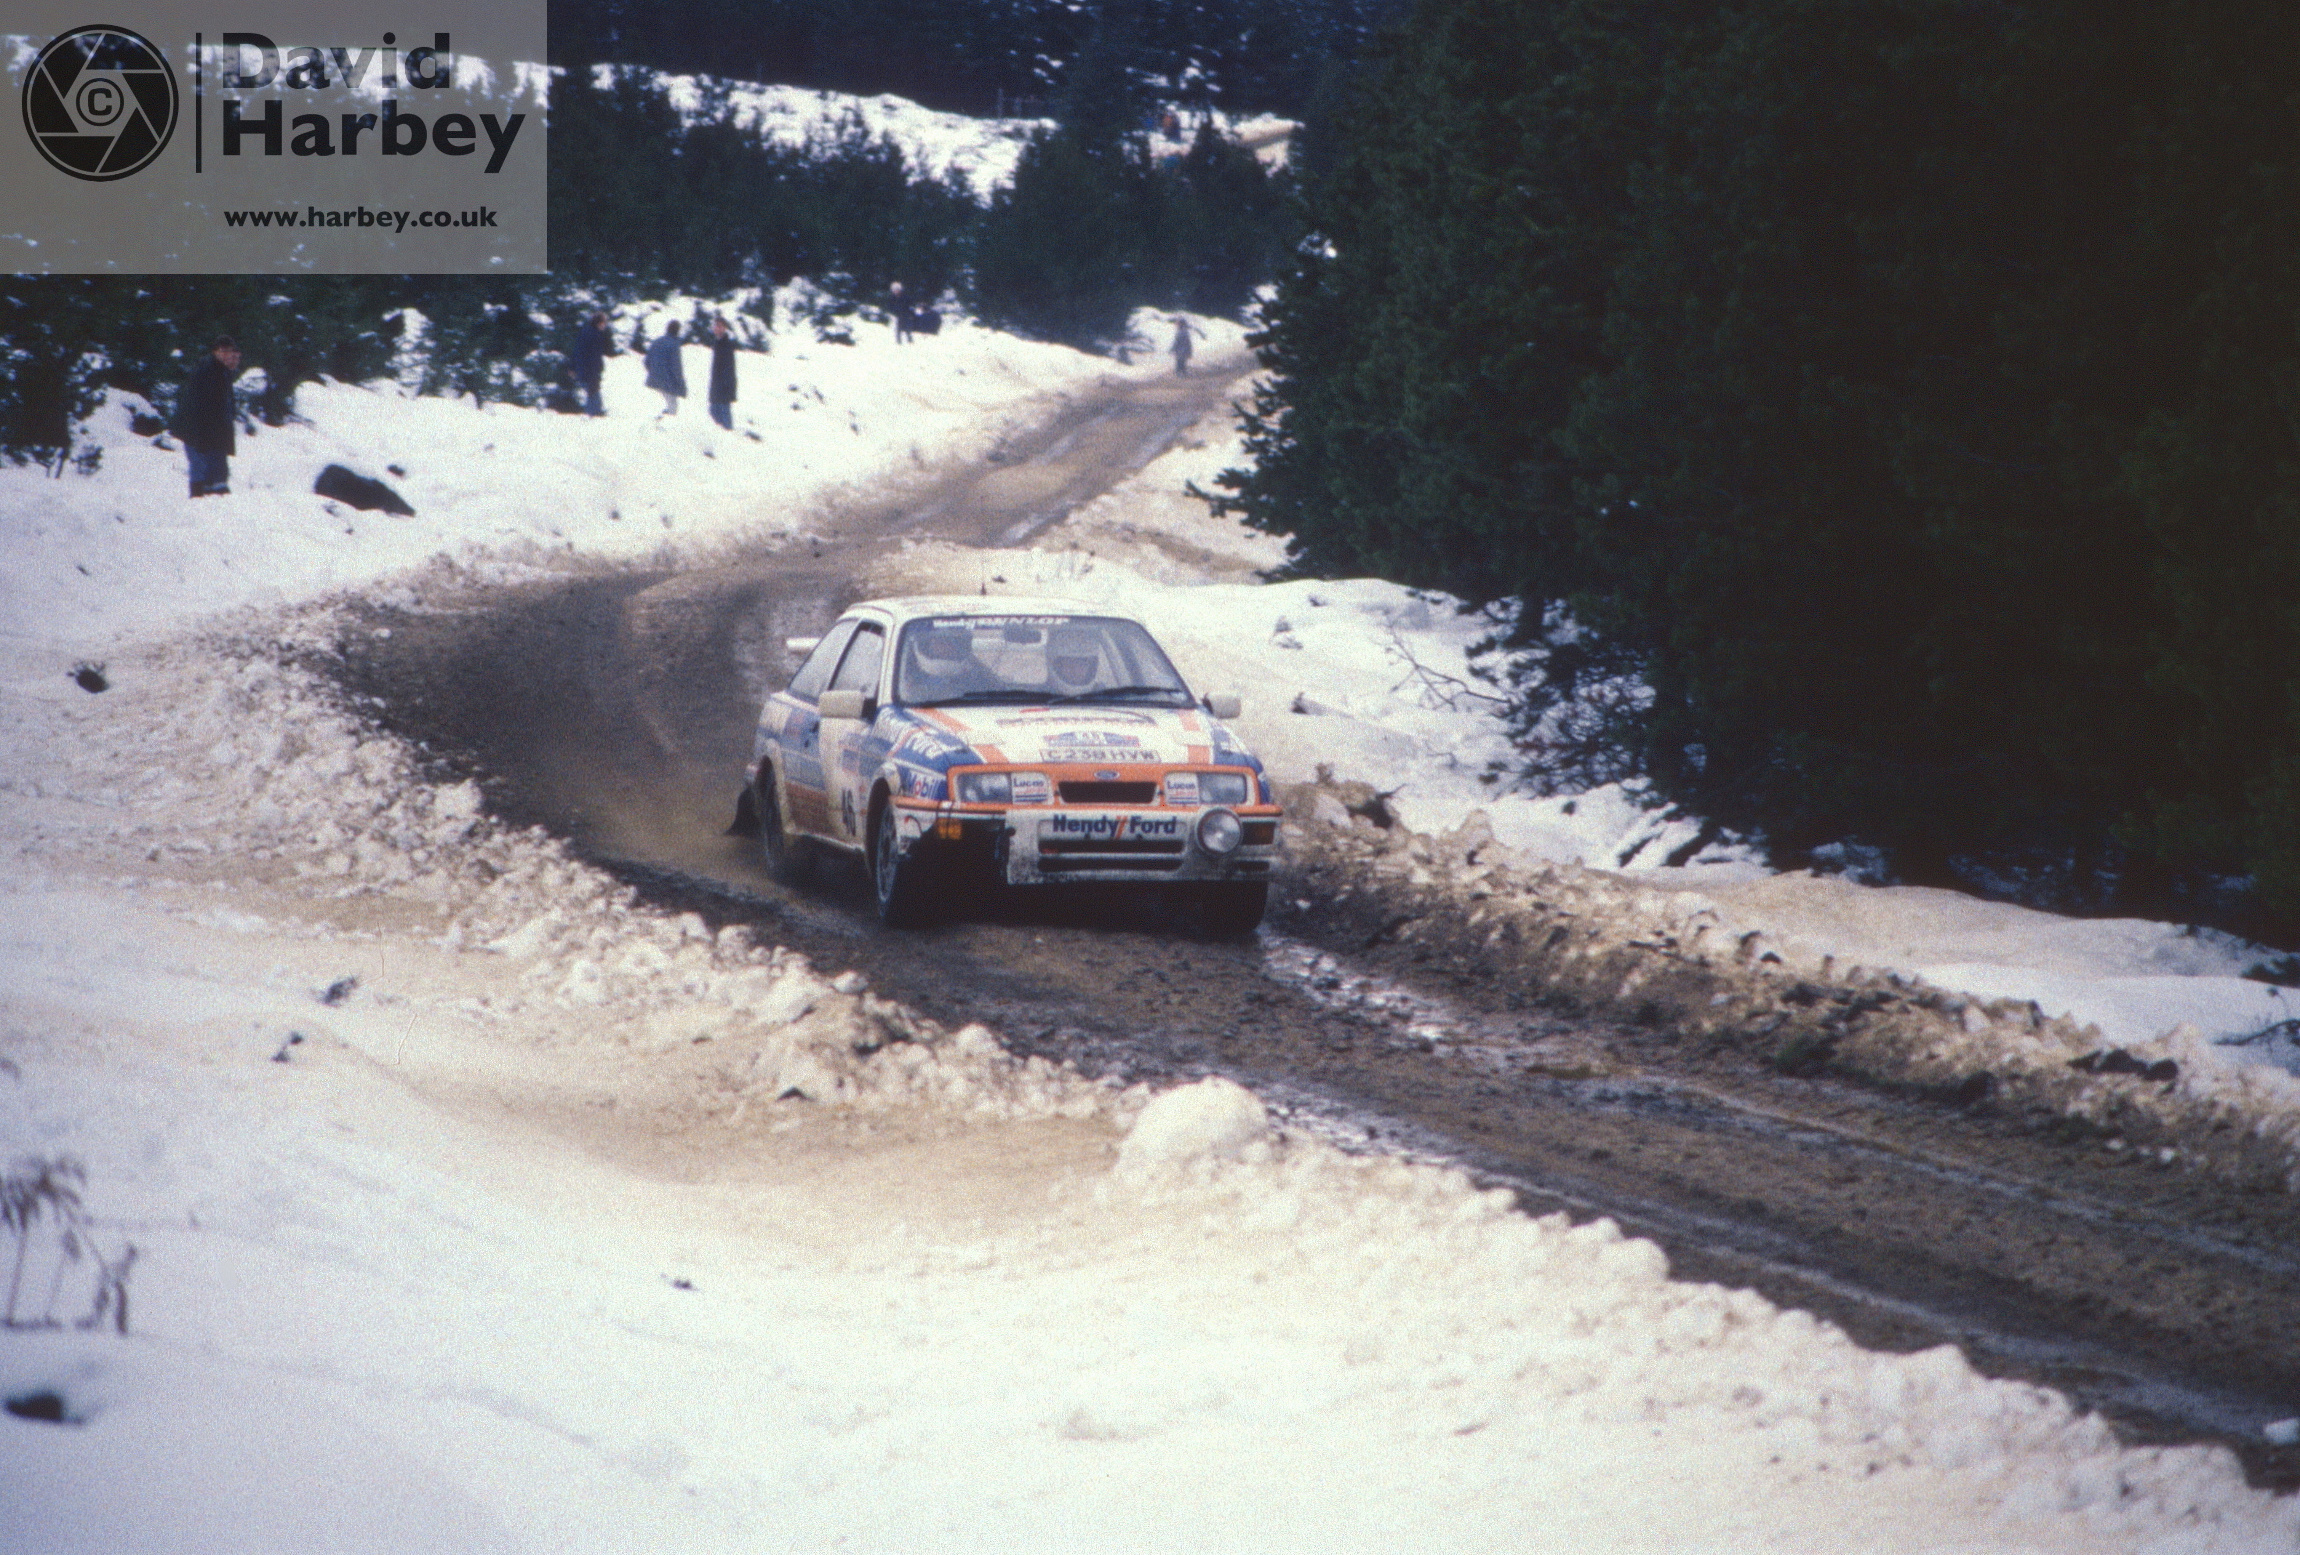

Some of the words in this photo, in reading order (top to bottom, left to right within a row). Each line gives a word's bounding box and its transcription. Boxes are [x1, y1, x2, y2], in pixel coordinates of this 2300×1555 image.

[1013, 777, 1045, 788] Lucas
[1167, 780, 1196, 790] Lucas
[1052, 814, 1118, 838] Hendy
[1129, 816, 1177, 834] Ford
